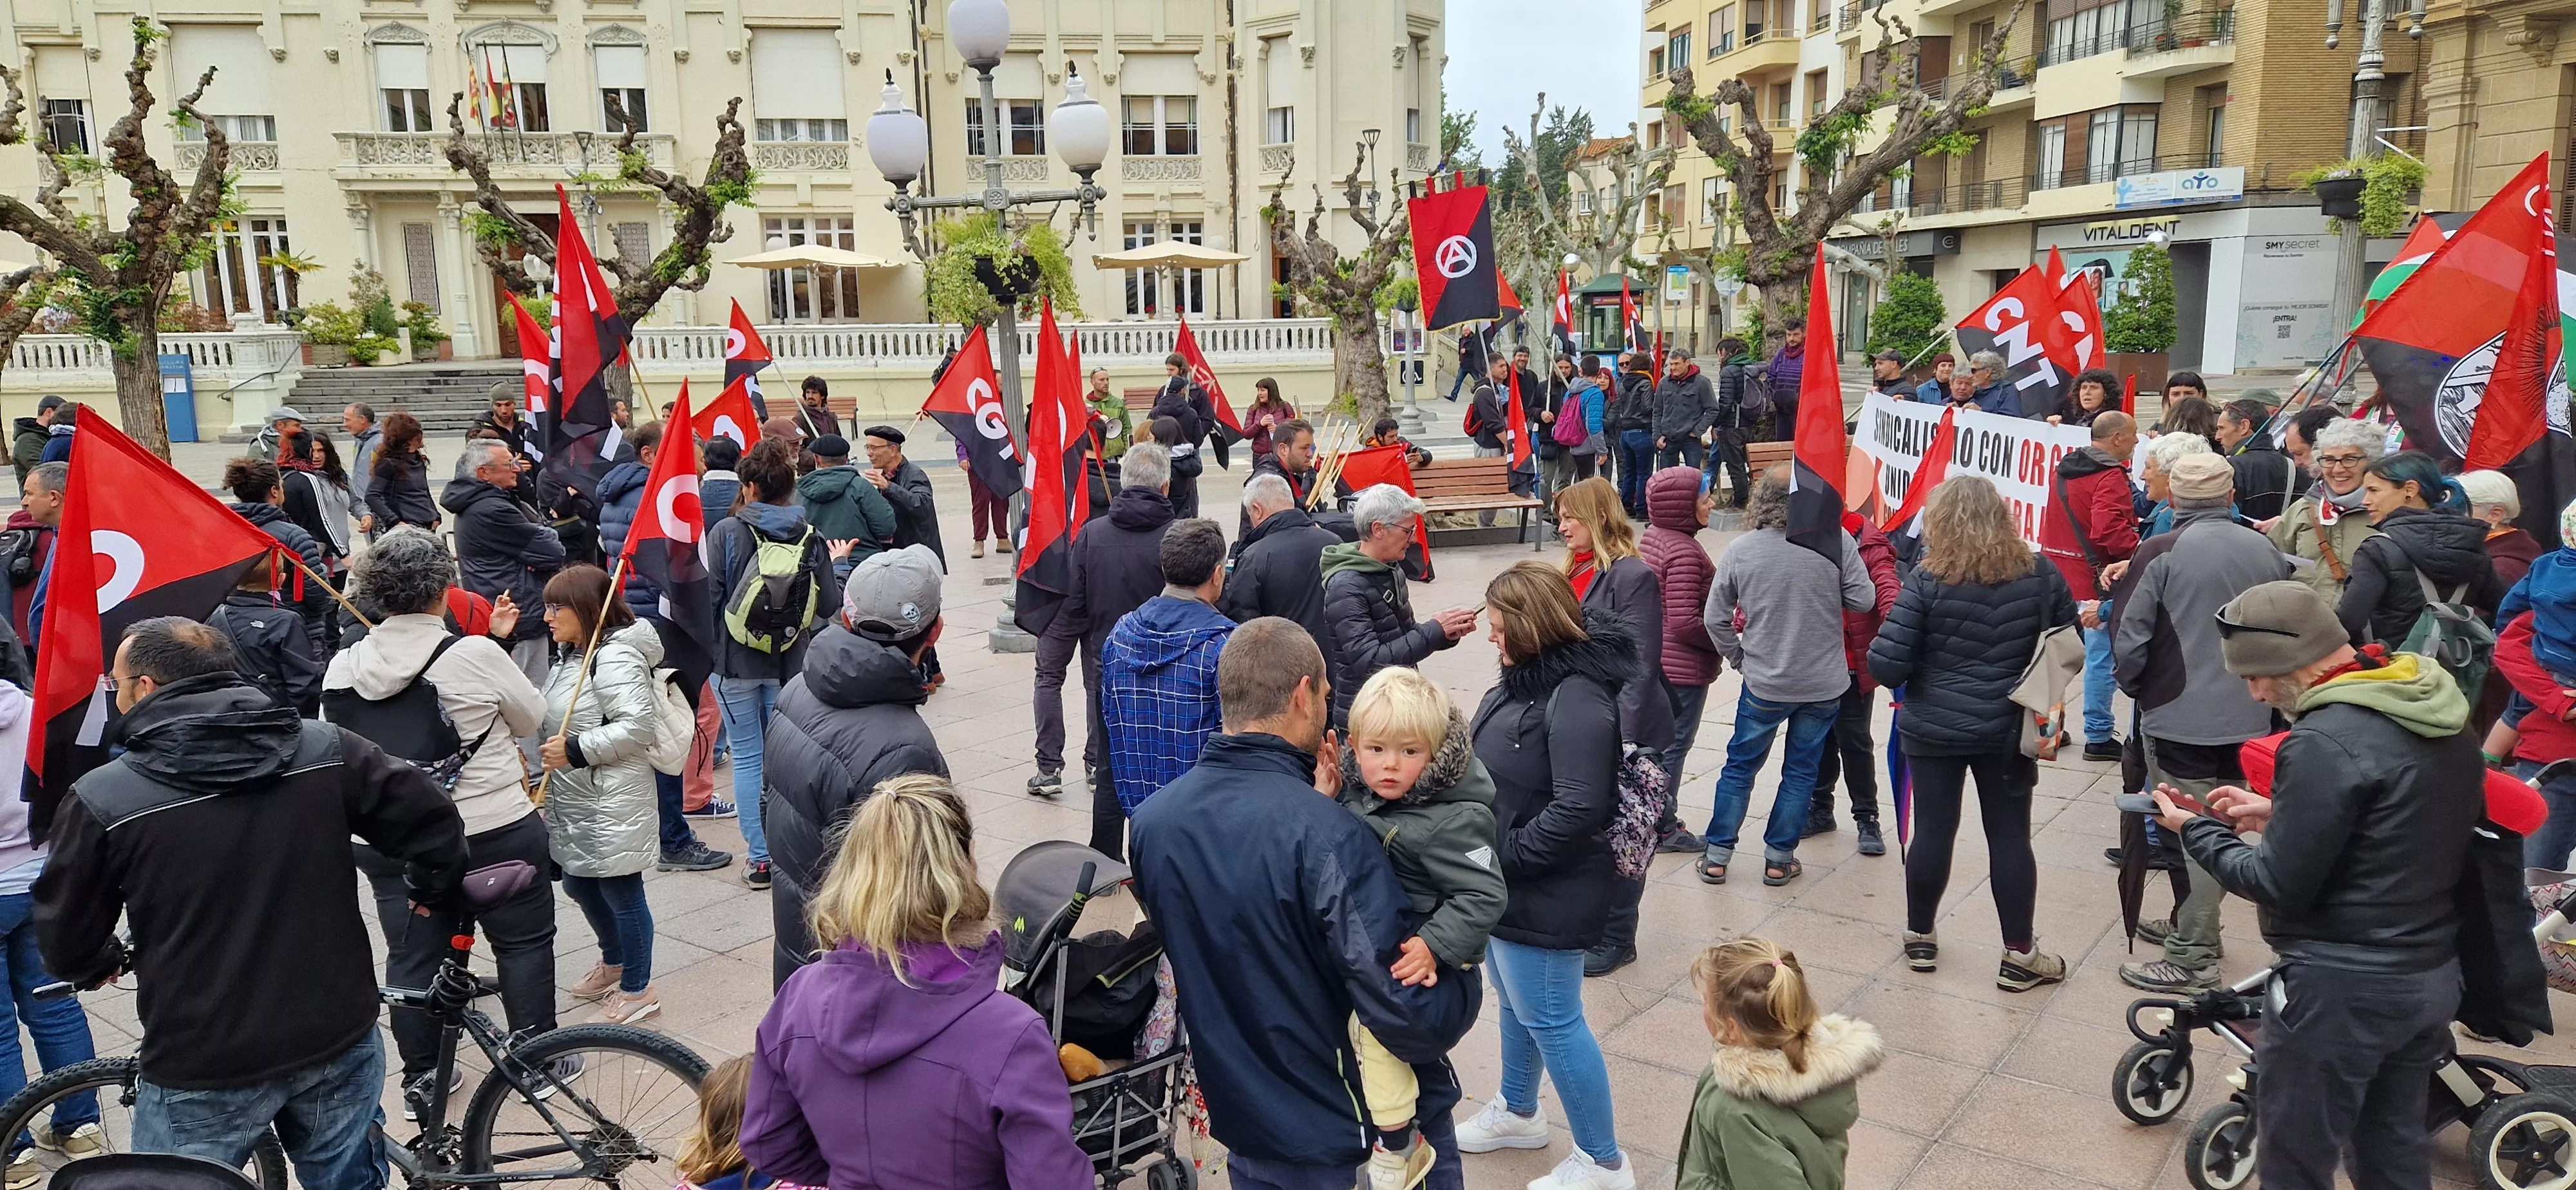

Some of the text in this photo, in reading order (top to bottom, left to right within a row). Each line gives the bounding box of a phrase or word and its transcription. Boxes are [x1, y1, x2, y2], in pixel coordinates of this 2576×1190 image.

[2083, 220, 2181, 241] VITALDENT
[1873, 241, 1883, 254] DE
[2273, 315, 2297, 323] ¡ENTRA!
[1985, 296, 2060, 392] CNT
[1978, 430, 2015, 478] CON
[2018, 438, 2080, 487] ORG
[1884, 463, 1911, 501] UNID
